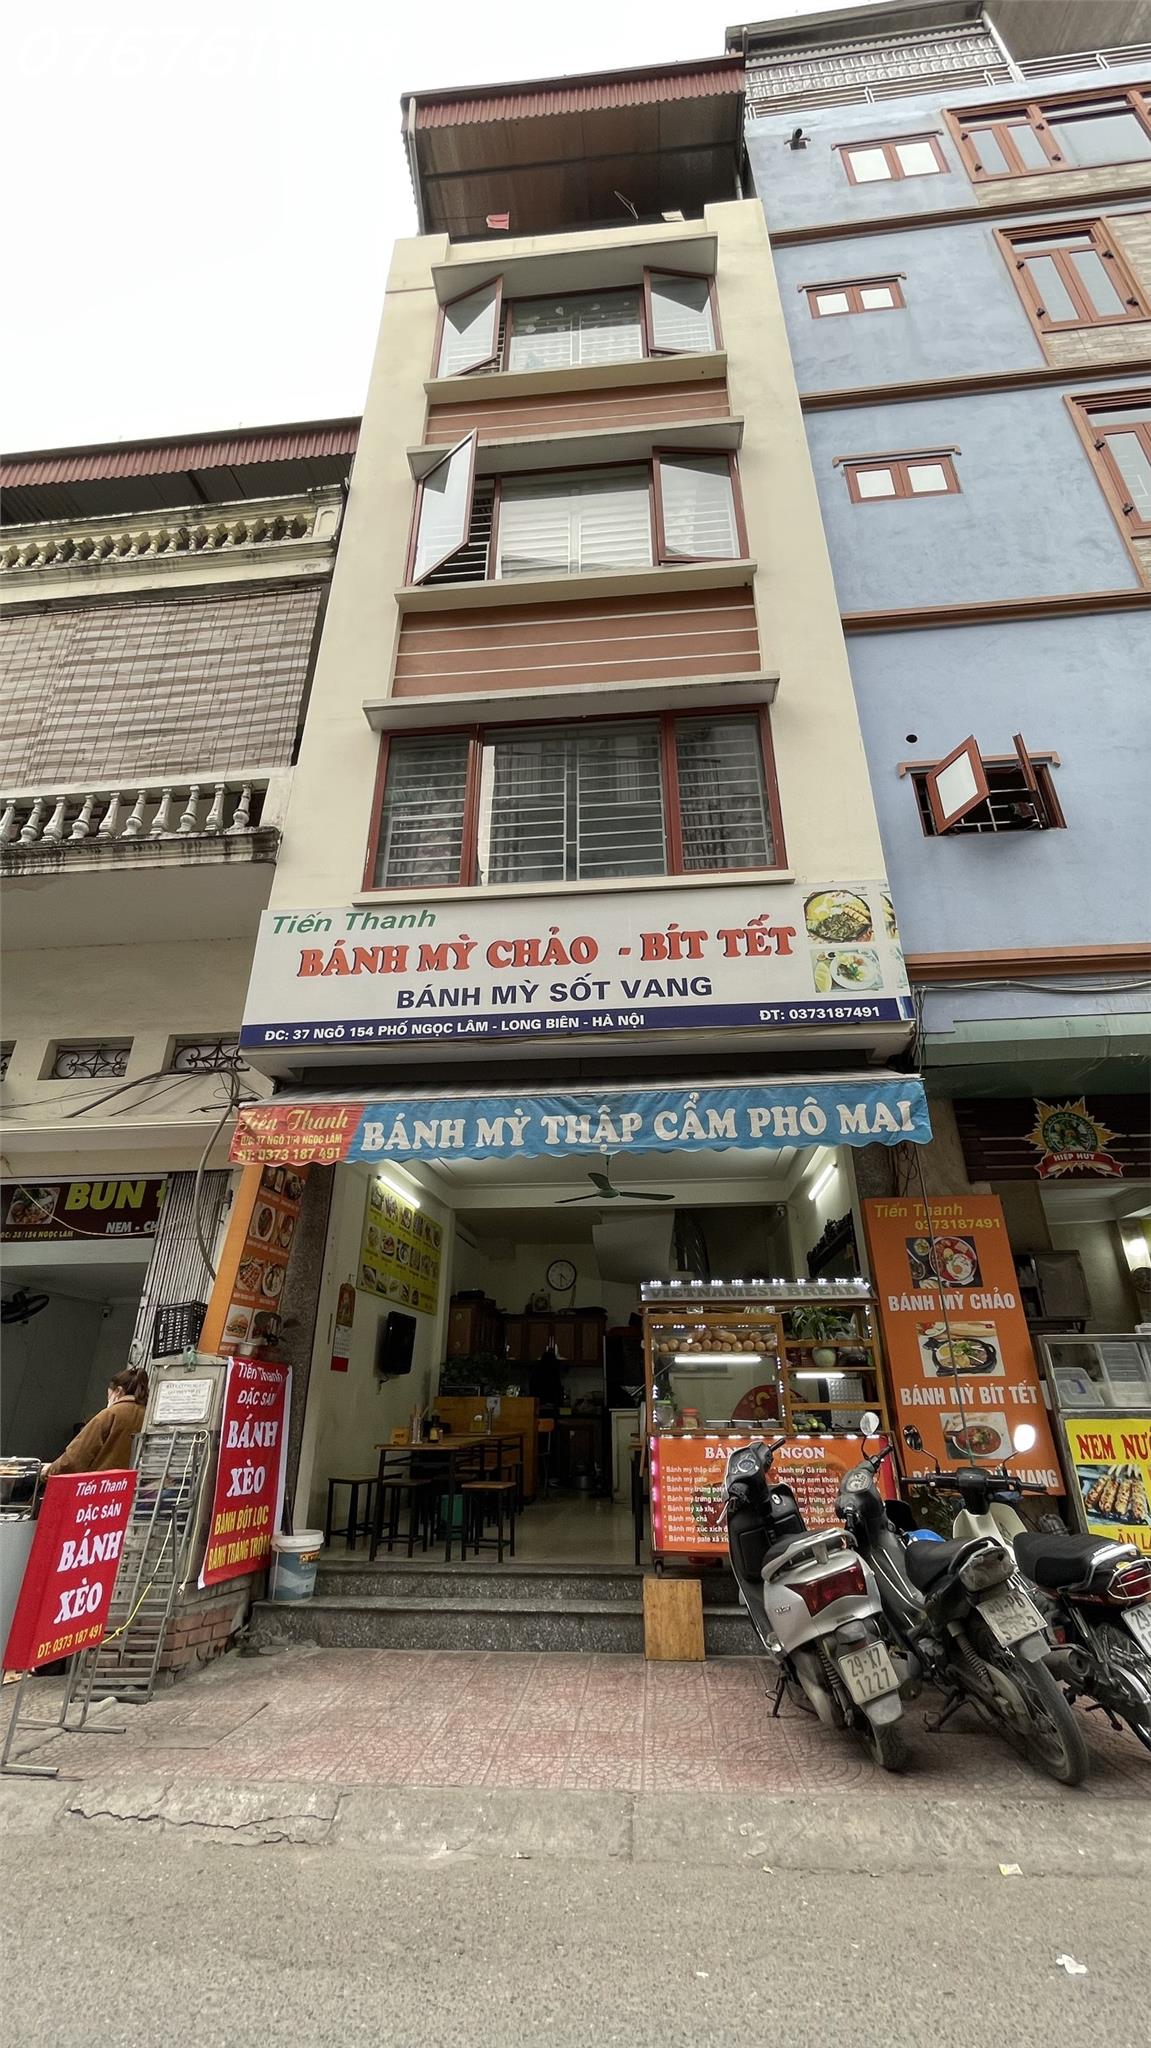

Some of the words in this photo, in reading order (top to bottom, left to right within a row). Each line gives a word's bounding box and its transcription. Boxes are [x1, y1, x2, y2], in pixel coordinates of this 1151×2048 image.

[273, 912, 332, 934] Tiến
[346, 910, 436, 931] Thanh
[297, 940, 409, 977] BÁNH
[417, 934, 478, 972] MỲ
[487, 926, 598, 969] CHẢO
[640, 923, 709, 961] BÍT
[717, 914, 797, 957] TẾT
[397, 984, 481, 1009] BÁNH
[492, 980, 539, 1005] MỲ
[550, 973, 611, 1002] SỐT
[620, 976, 712, 999] VANG
[265, 1029, 289, 1041] ĐC:
[292, 1029, 309, 1039] 37
[314, 1025, 345, 1039] NGÕ
[350, 1027, 374, 1037] 154
[378, 1021, 408, 1036] PHỐ
[411, 1023, 453, 1037] NGỌC
[457, 1019, 488, 1033] LÂM
[501, 1019, 541, 1031] LONG
[546, 1015, 579, 1029] BIÊN
[592, 1013, 613, 1027] HÀ
[618, 1013, 645, 1028] NỘI
[759, 1009, 785, 1021] ĐT:
[789, 1006, 880, 1020] 0373187491
[286, 1109, 348, 1131] Thanh
[361, 1113, 466, 1150] BÁNH
[476, 1108, 531, 1147] MỲ
[540, 1105, 643, 1152] THẬP
[653, 1092, 737, 1141] CẨM
[747, 1096, 827, 1138] PHÔ
[835, 1101, 915, 1134] MAI
[258, 1149, 289, 1161] 0373
[293, 1149, 315, 1160] 187
[319, 1148, 340, 1159] 491
[874, 1201, 908, 1218] Tiến
[913, 1203, 963, 1217] Thanh
[106, 1221, 132, 1234] NEM
[915, 1218, 1000, 1231] 0373187491
[650, 1284, 785, 1299] VIETNAMESE
[787, 1284, 860, 1297] BREAD
[888, 1292, 935, 1311] BÁNH
[939, 1291, 964, 1310] MỲ
[970, 1286, 1016, 1310] CHẢO
[238, 1362, 257, 1380] Tiến
[257, 1366, 283, 1382] Thanh
[237, 1387, 260, 1409] ĐẶC
[900, 1384, 946, 1406] BÁNH
[950, 1383, 974, 1405] MỲ
[979, 1383, 1005, 1404] BÍT
[1008, 1379, 1037, 1404] TẾT
[226, 1413, 278, 1449] BÁNH
[780, 1447, 825, 1459] NGON
[1076, 1433, 1117, 1460] NEM
[76, 1479, 97, 1497] Tiến
[99, 1477, 128, 1494] Thanh
[226, 1459, 266, 1498] XÈO
[76, 1503, 100, 1526] ĐẶC
[101, 1499, 122, 1519] SẢN
[214, 1508, 236, 1536] BÁNH
[236, 1504, 252, 1533] BỘT
[252, 1505, 269, 1530] LỌC
[57, 1528, 123, 1573] BÁNH
[53, 1577, 103, 1625] XÈO
[37, 1642, 52, 1659] ĐT:
[53, 1635, 73, 1653] 0373
[75, 1629, 88, 1645] 187
[89, 1624, 103, 1639] 491
[847, 1647, 883, 1677] 29-X7
[856, 1667, 891, 1698] 1227
